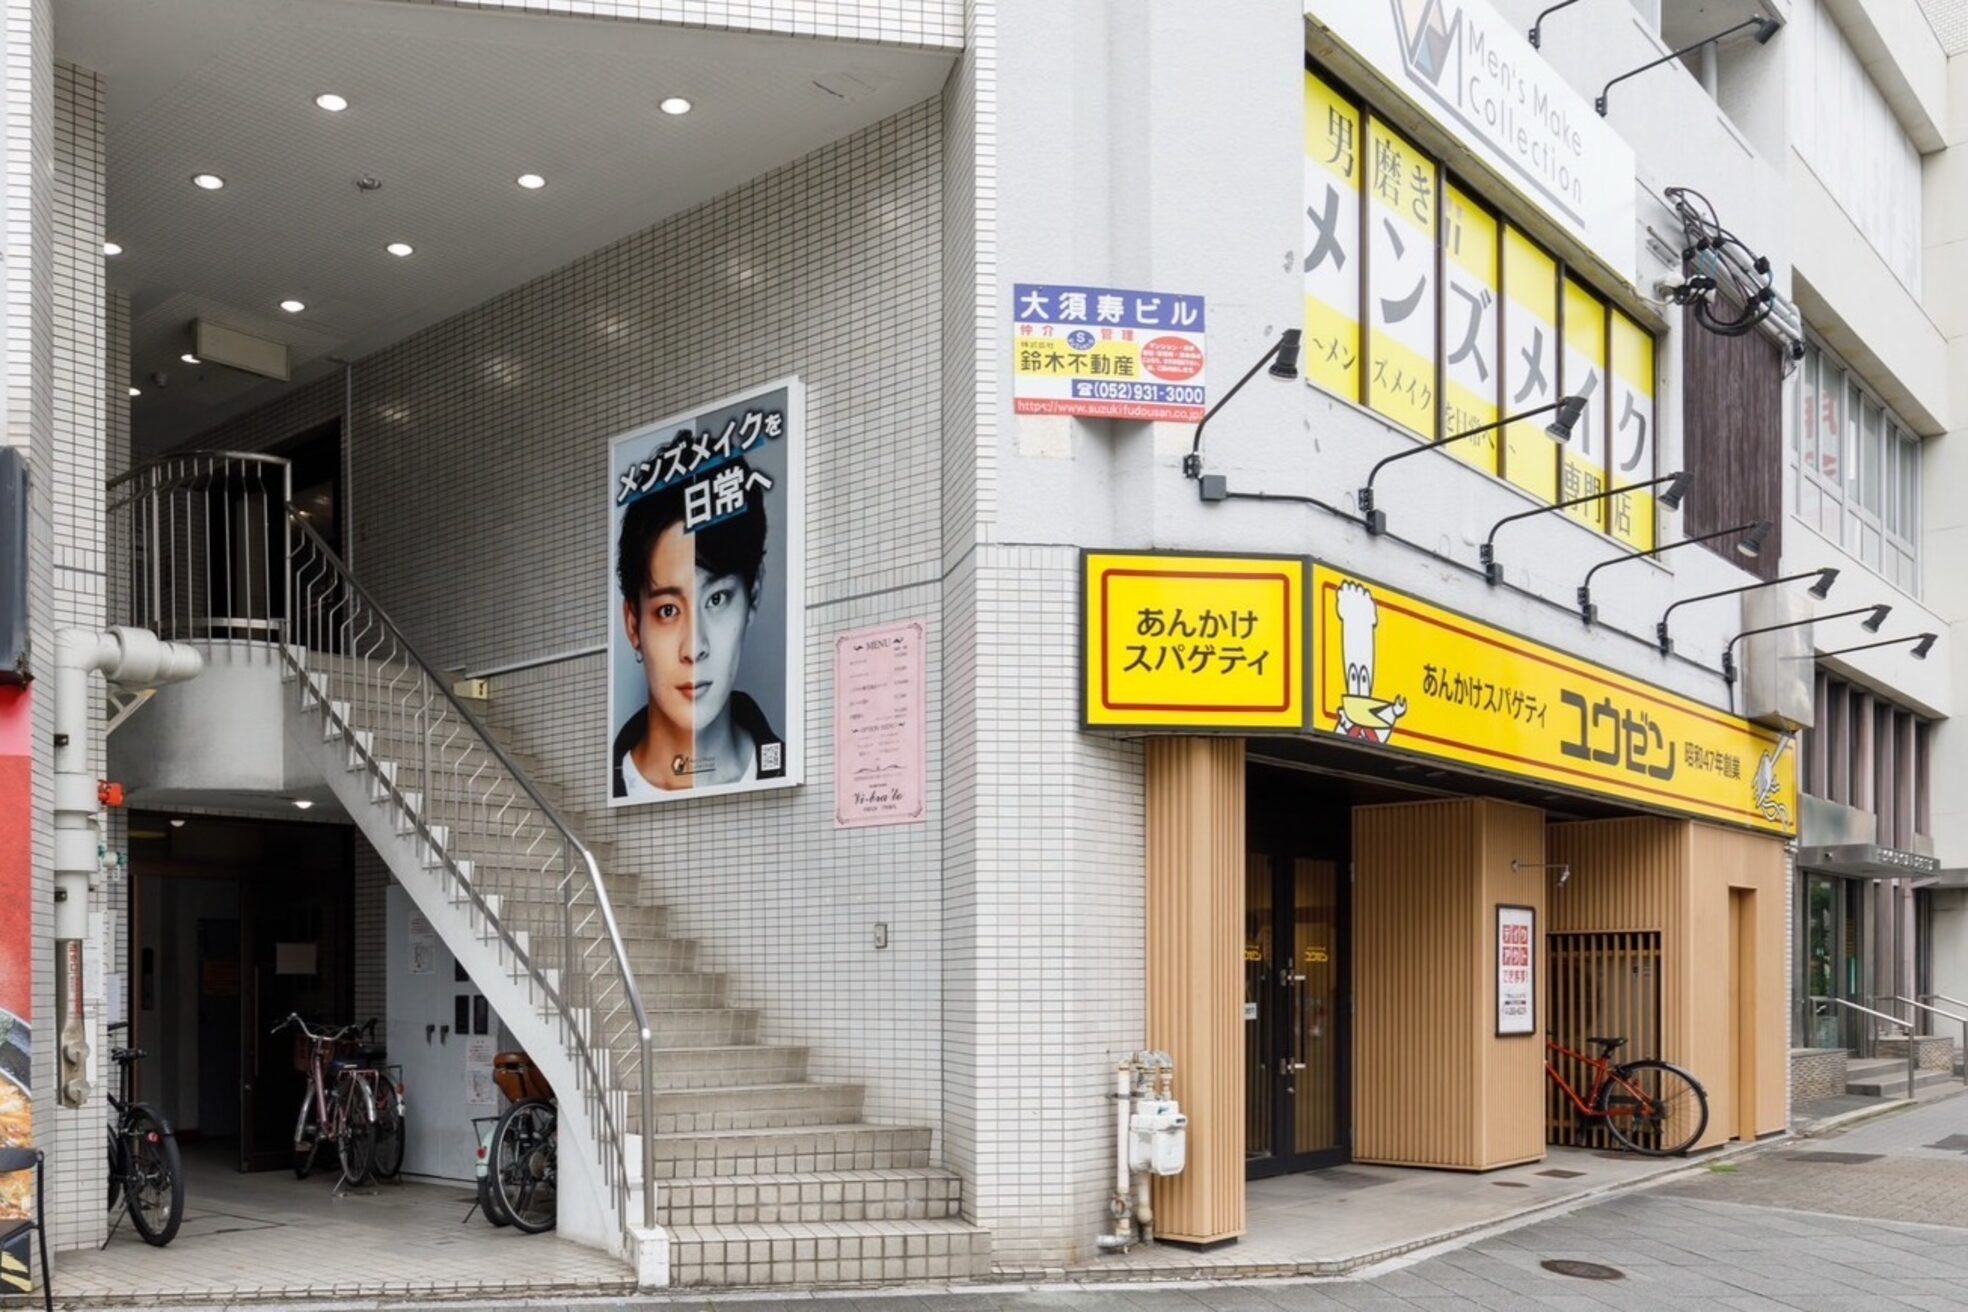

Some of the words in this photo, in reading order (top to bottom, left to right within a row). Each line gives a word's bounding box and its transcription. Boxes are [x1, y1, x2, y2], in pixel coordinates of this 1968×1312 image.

[1469, 20, 1525, 104] Men's
[1534, 83, 1582, 157] Make
[1469, 76, 1582, 204] Collection
[1020, 290, 1198, 326] 大須寿ビル
[1020, 350, 1134, 377] 鈴木不動産
[617, 411, 783, 503] メンズメイクを
[684, 465, 773, 530] 日常へ
[866, 638, 891, 651] MENU
[1136, 607, 1259, 640] あんかけ
[1122, 643, 1270, 676] スパゲティ
[1422, 663, 1548, 729] あんかけスパゲティ
[1560, 688, 1676, 781] ユウゼン
